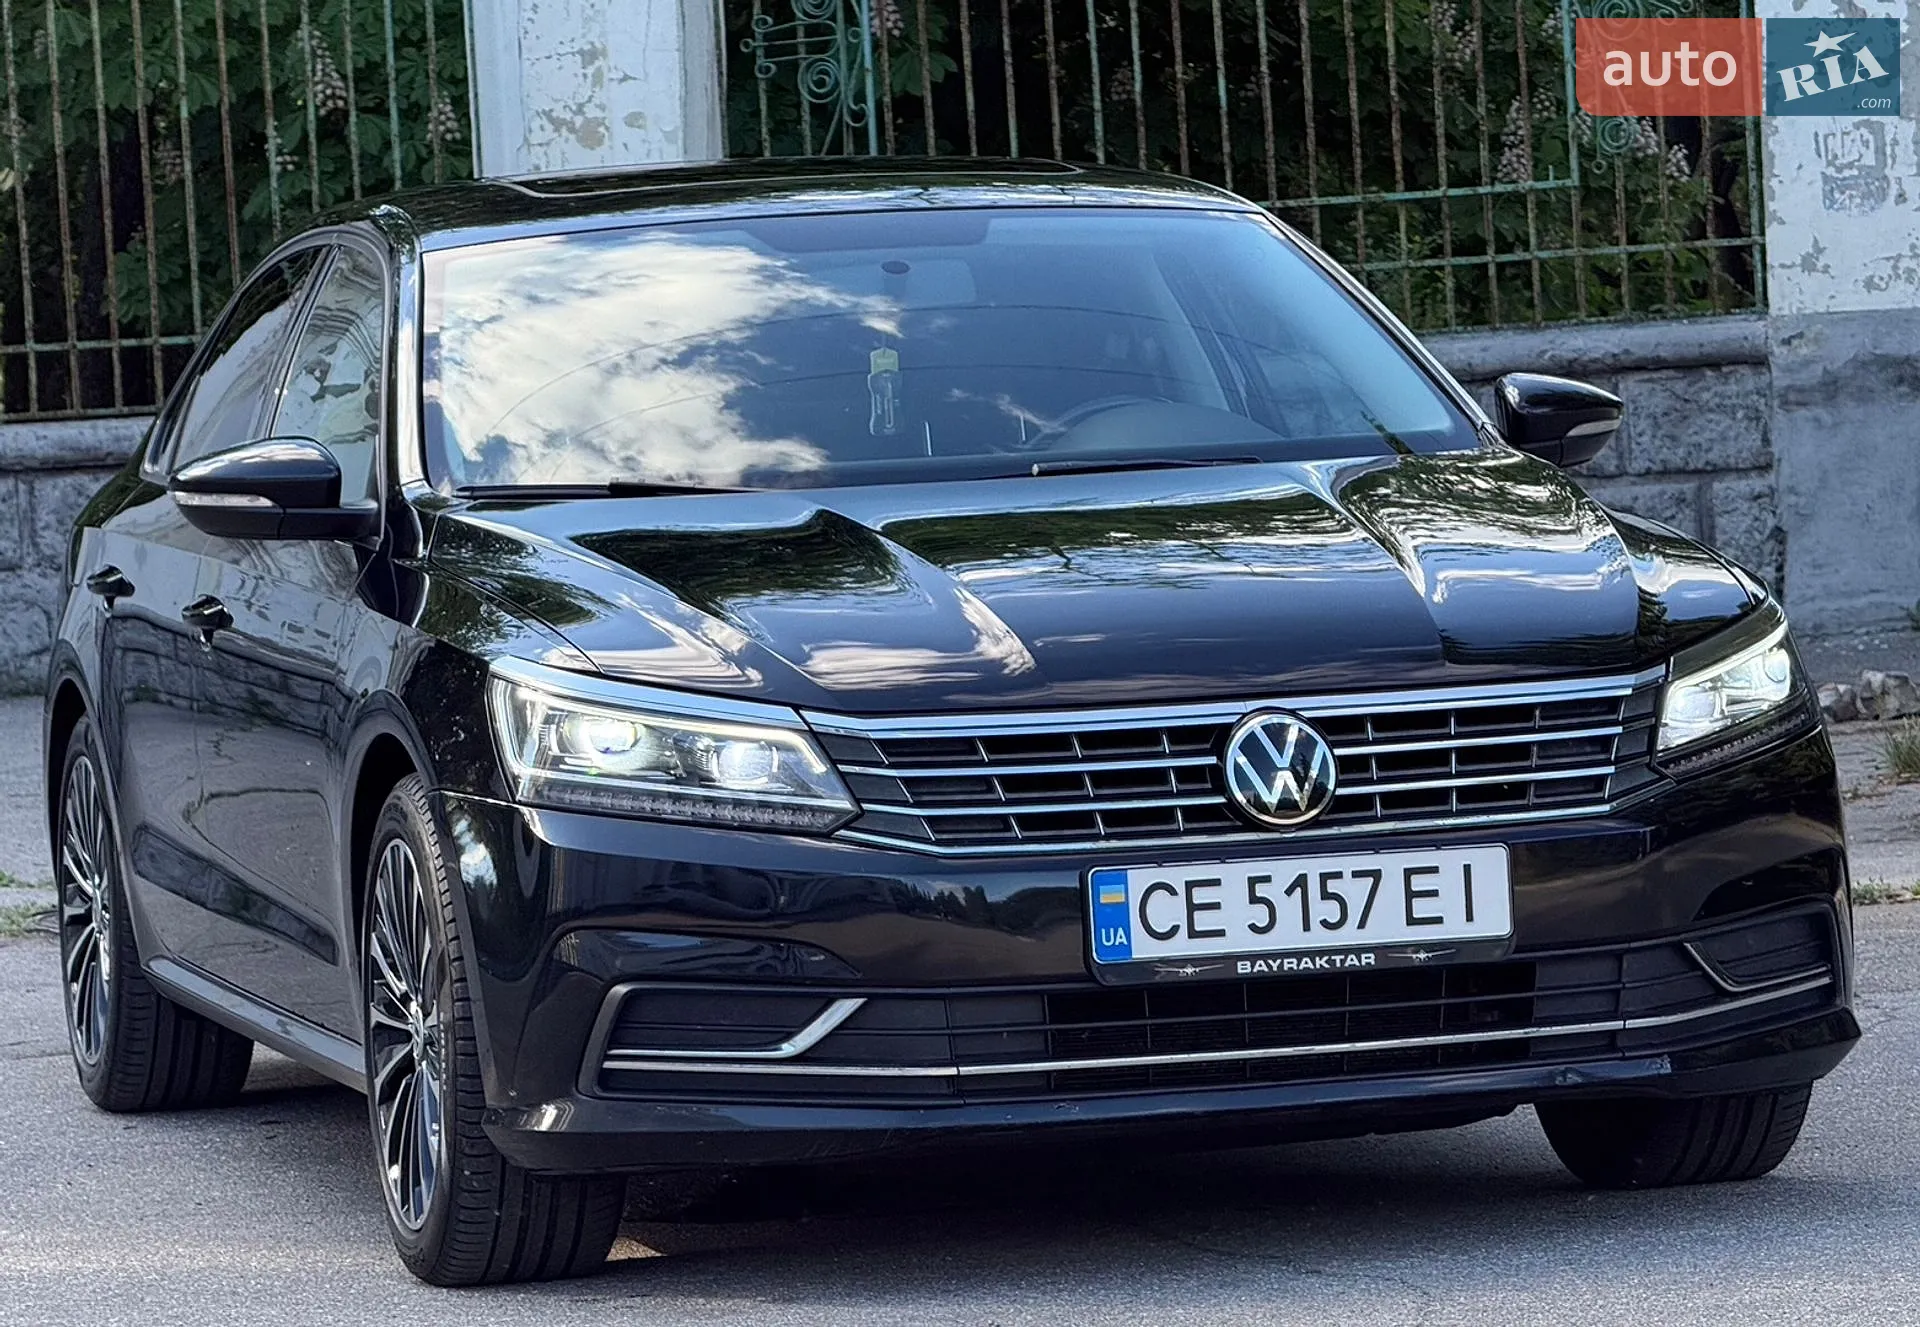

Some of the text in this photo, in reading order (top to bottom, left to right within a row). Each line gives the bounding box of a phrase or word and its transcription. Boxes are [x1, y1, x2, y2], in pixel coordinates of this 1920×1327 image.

[1138, 877, 1226, 941] CE
[1246, 868, 1384, 934] 5157
[1101, 926, 1129, 946] UA
[1236, 952, 1376, 974] BAYRAKTAR
